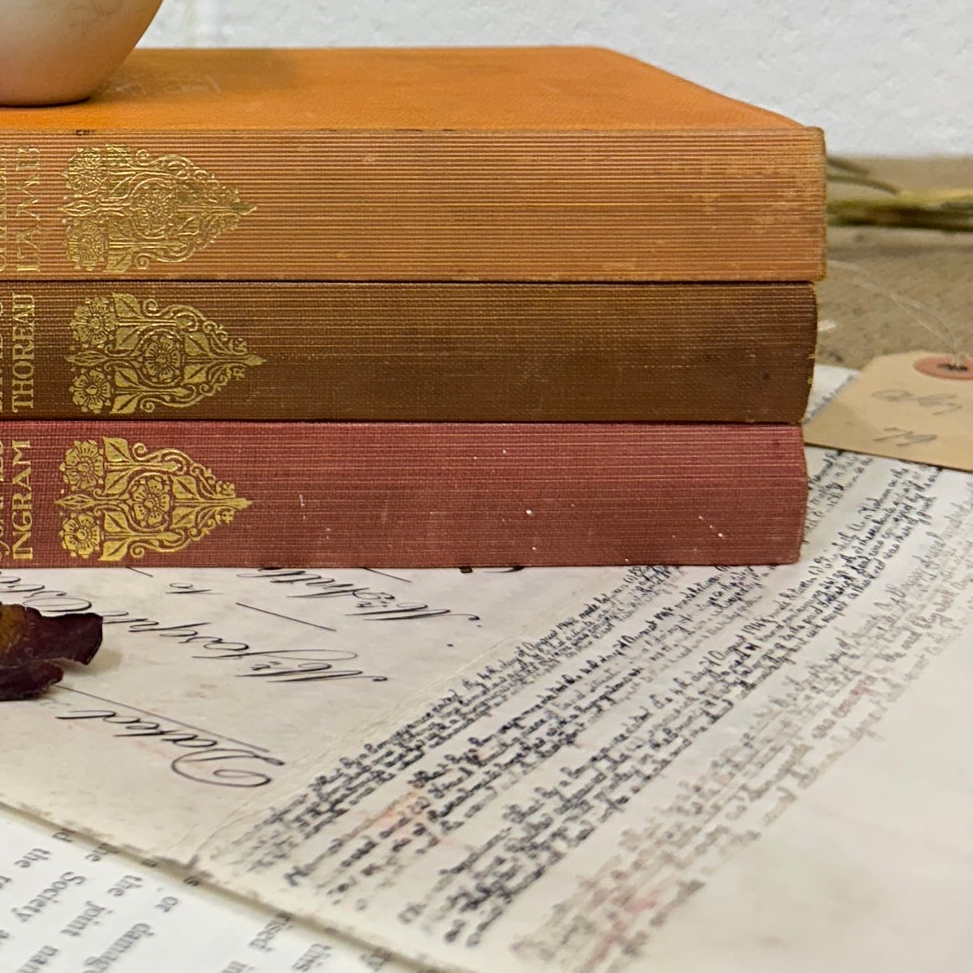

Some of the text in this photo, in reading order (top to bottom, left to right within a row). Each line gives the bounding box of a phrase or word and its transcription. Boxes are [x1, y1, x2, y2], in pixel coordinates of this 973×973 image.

[12, 292, 35, 413] THOREAU
[12, 439, 34, 561] INGRAM
[55, 709, 285, 788] Dated
[11, 871, 87, 923] Society
[14, 848, 51, 869] the
